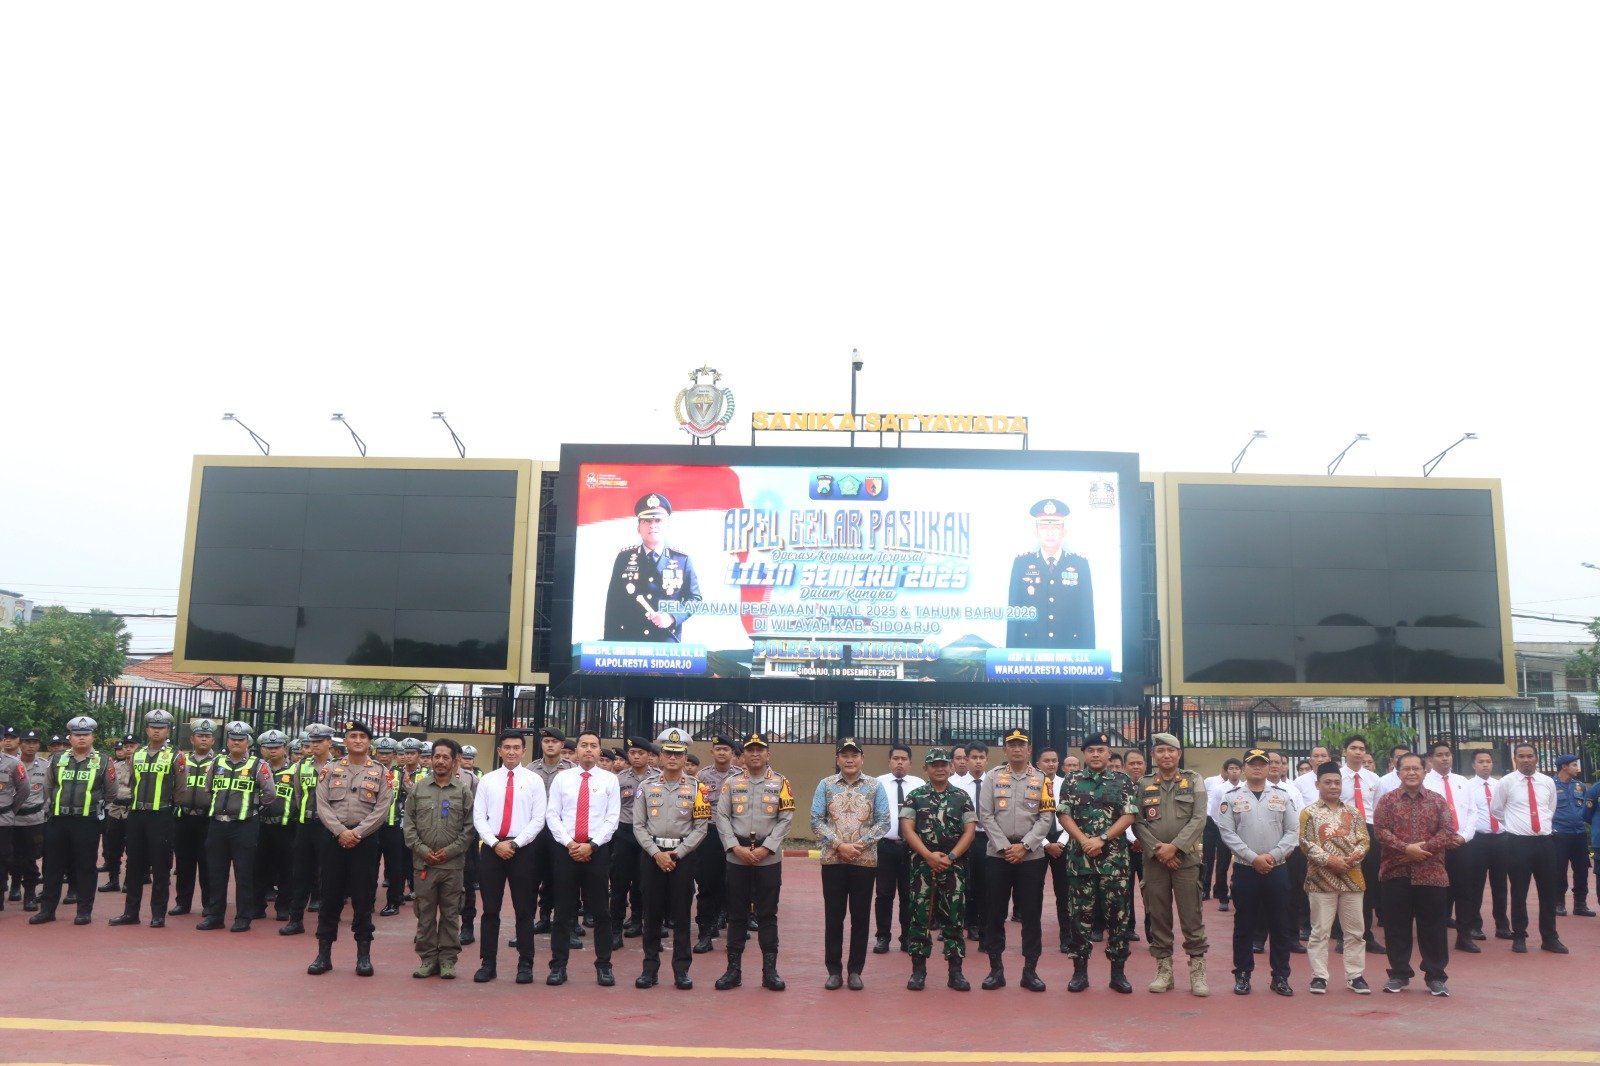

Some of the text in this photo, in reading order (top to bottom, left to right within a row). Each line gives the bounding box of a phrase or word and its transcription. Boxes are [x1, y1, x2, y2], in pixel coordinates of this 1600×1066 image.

[753, 411, 855, 431] SANIKA
[723, 508, 970, 558] APEL GELAR PASUKAN
[771, 549, 813, 562] Operasi
[725, 562, 970, 591] LILIN SEMERU 2025
[799, 586, 895, 603] Dalam Rangka
[659, 601, 1037, 620] PELAYANAN PERAYAAN NATAL 2025 & TAHUN BARU 2026
[754, 618, 941, 634] DI WILAYAH KAB. SIDOARJO
[754, 639, 941, 661] POLRESTA SIDOARJO
[595, 657, 692, 670] KAPOLRESTA SIDOARJO
[994, 664, 1104, 677] WAKAPOLRESTA SIDOARJO
[797, 666, 896, 678] SIDOARJO, 19 DESEMBER 2025
[213, 779, 254, 791] POLISI
